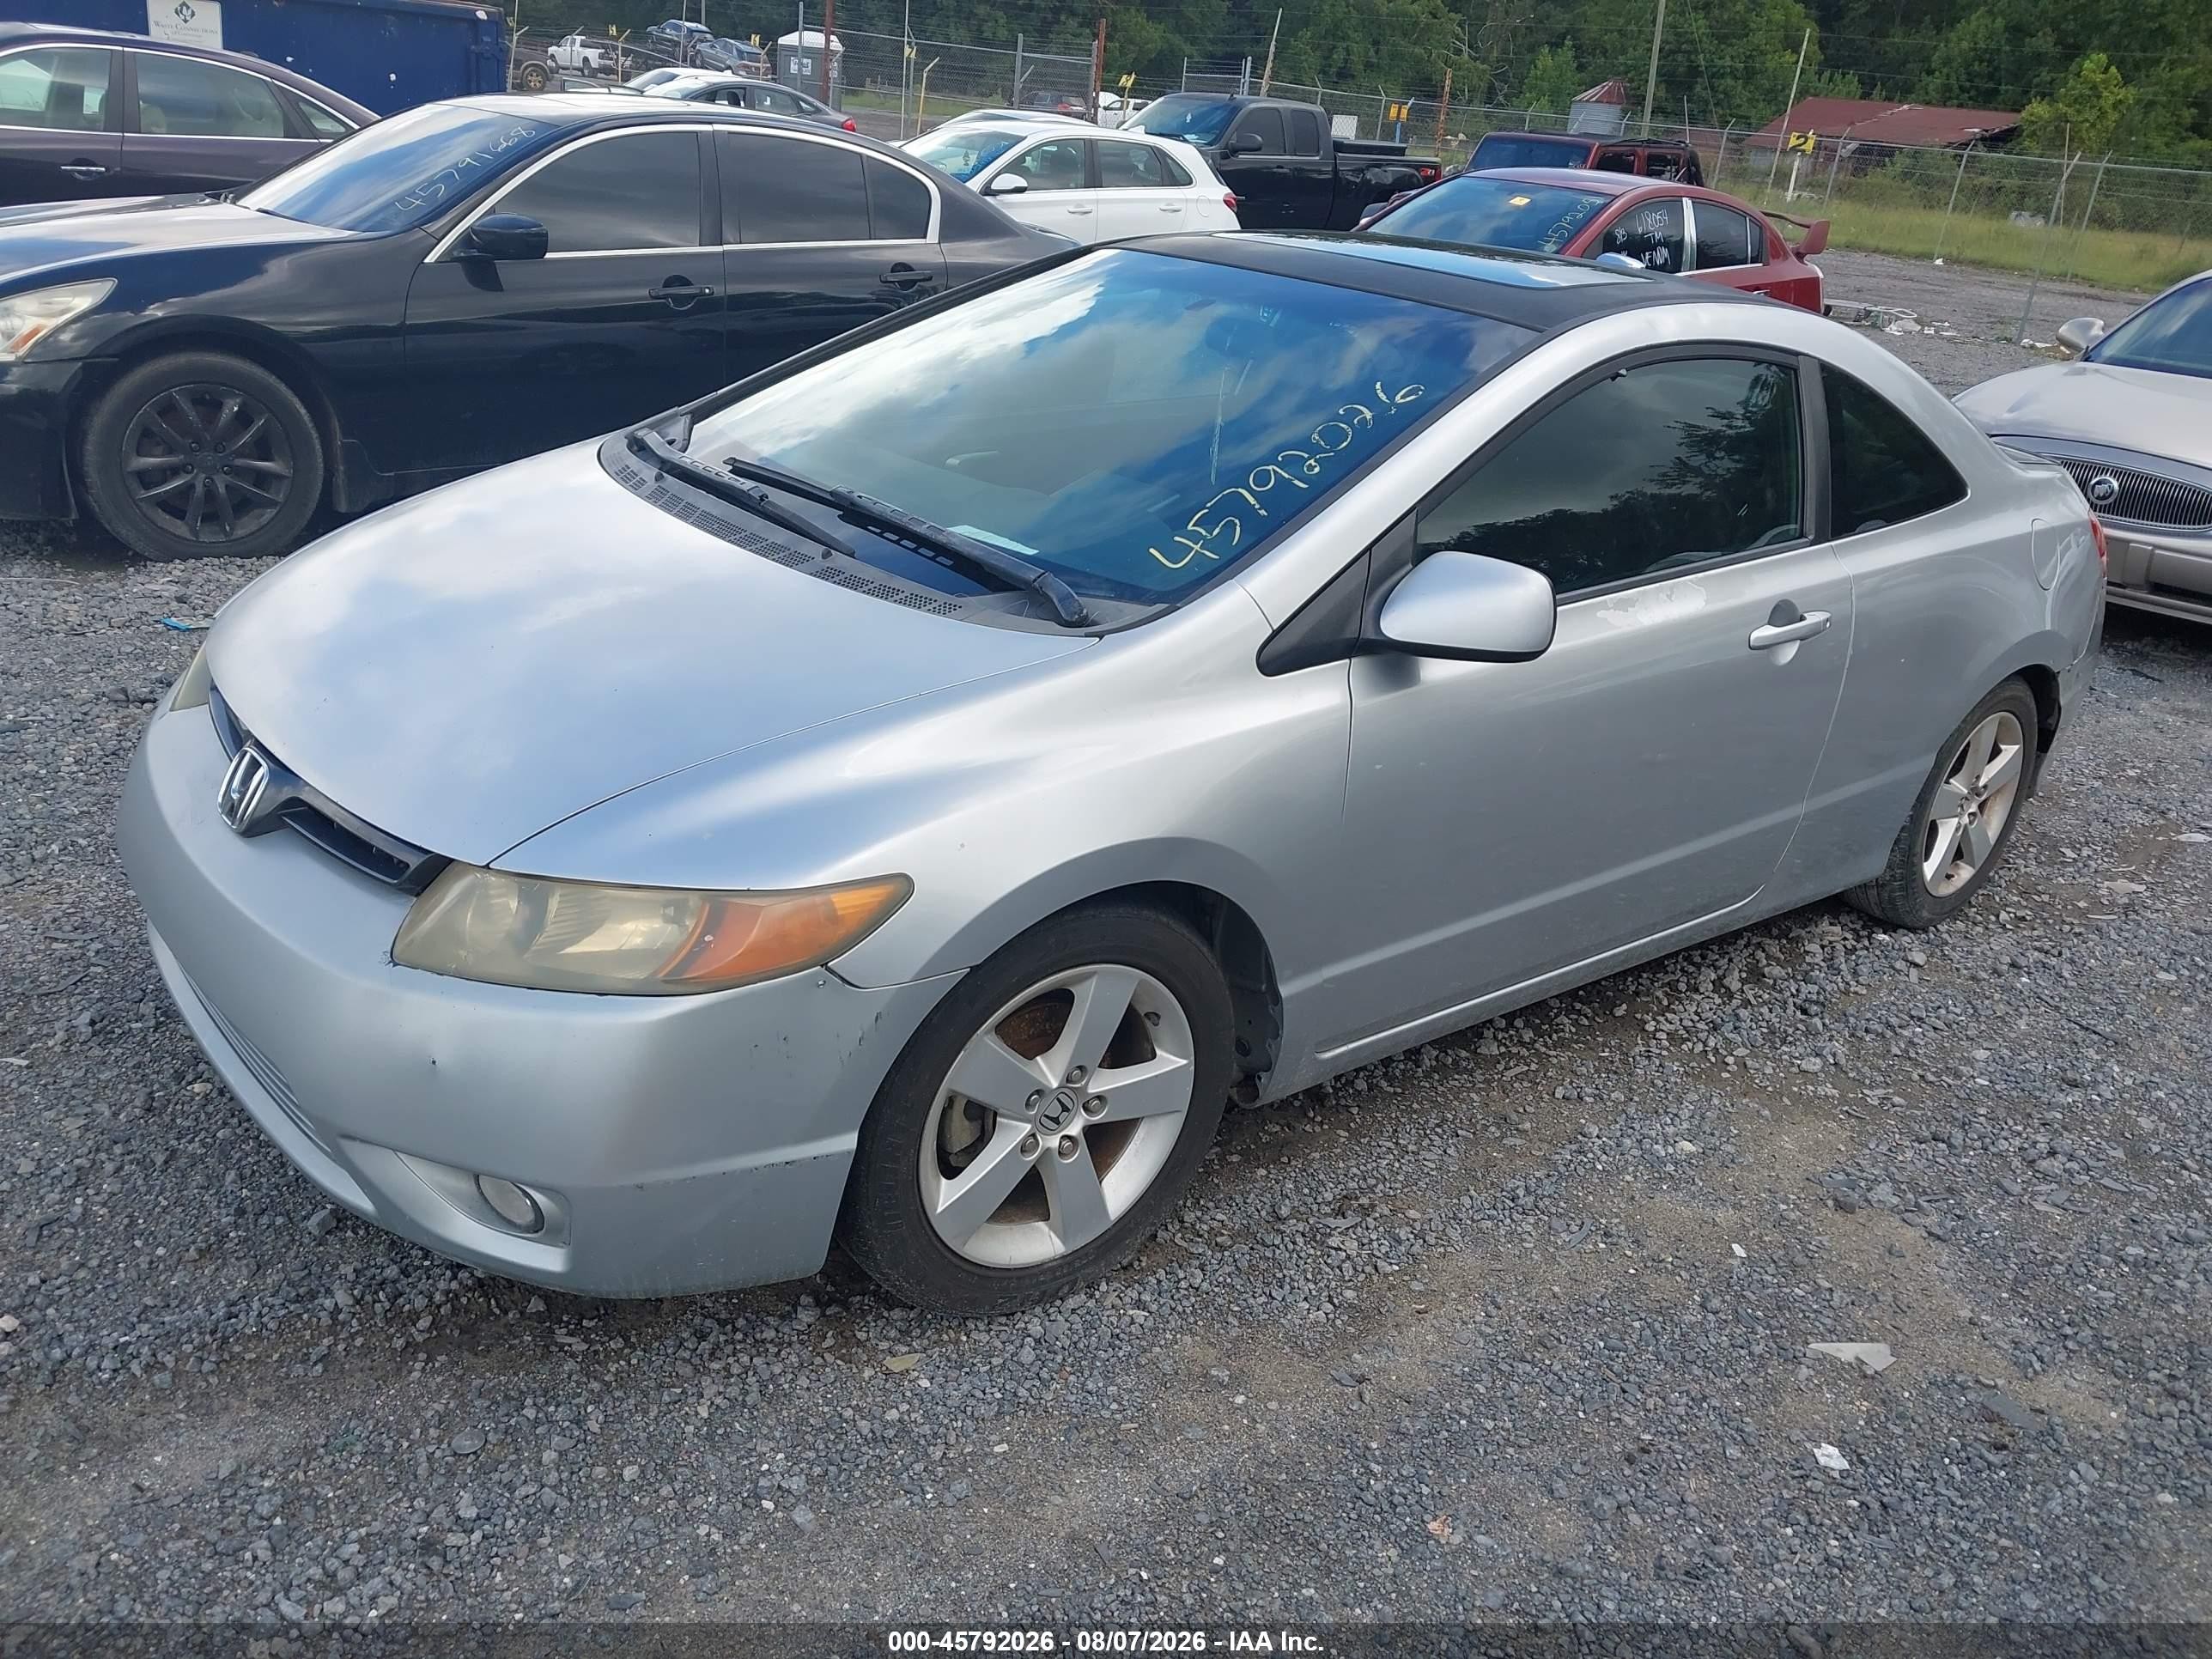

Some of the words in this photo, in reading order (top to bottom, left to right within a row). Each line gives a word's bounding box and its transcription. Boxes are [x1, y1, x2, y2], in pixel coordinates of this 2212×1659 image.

[1788, 135, 1809, 152] 2
[395, 126, 535, 210] 45791668
[1644, 231, 1664, 244] TM
[1641, 246, 1671, 266] VENOM
[1149, 381, 1425, 568] 45792026
